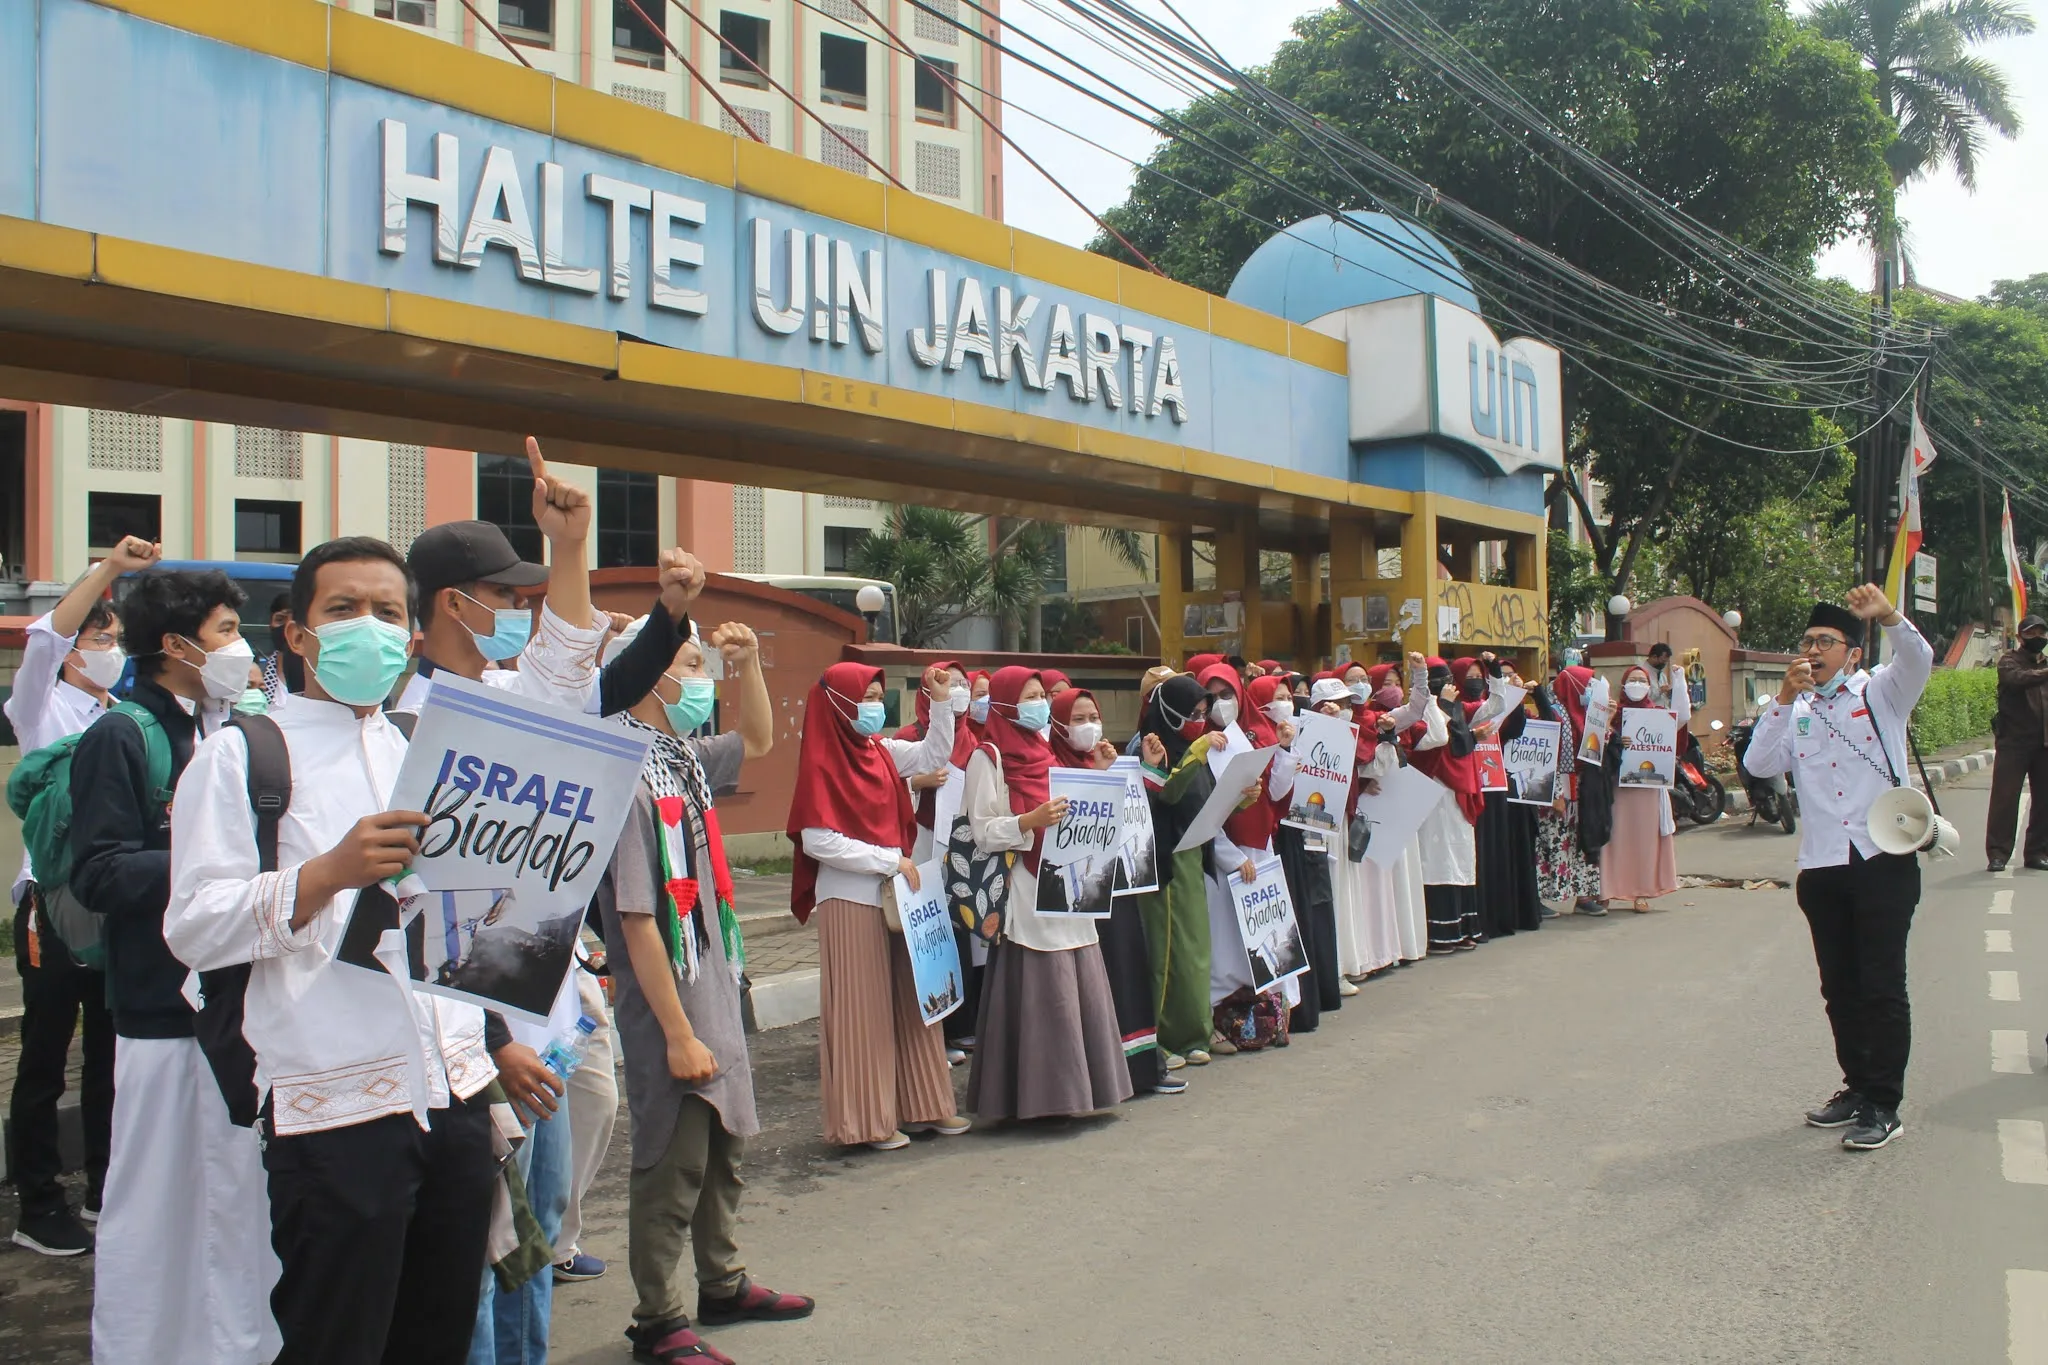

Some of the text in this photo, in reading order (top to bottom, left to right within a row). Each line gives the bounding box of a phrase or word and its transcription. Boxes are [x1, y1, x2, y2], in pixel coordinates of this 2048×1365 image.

[379, 117, 1188, 425] HALTE UIN JAKARTA
[1515, 736, 1551, 748] SRAEL
[1636, 726, 1663, 745] Save
[1311, 741, 1341, 770] Save
[1511, 738, 1553, 767] Biadab
[437, 749, 596, 823] ISRAEL
[1302, 764, 1348, 784] ALESTINA
[415, 782, 595, 892] Biadab
[1056, 812, 1116, 852] Biadab
[1241, 883, 1281, 908] ISRAEL
[907, 899, 942, 930] ISRAEL
[1243, 895, 1287, 936] Biadab
